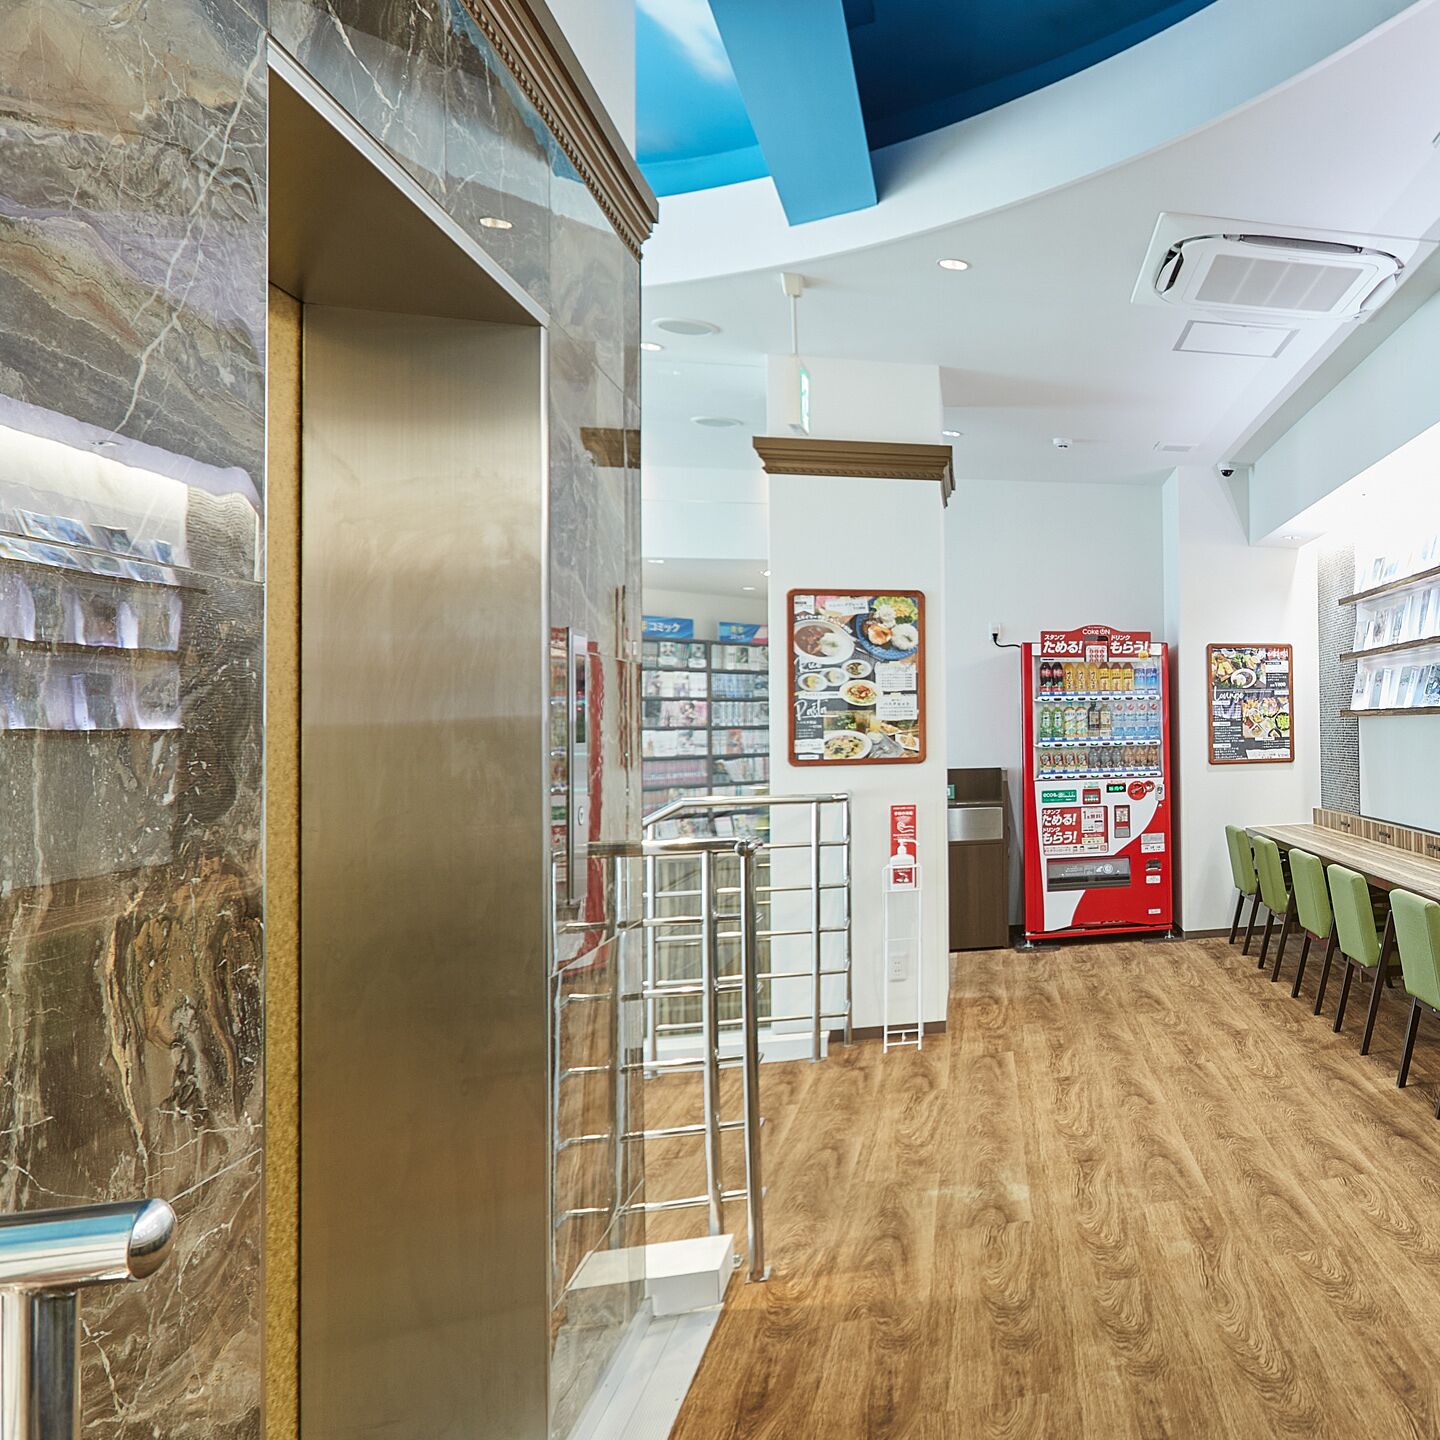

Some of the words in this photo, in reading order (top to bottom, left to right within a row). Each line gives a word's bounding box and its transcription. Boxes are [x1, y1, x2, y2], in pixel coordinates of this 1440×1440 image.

[649, 622, 680, 633] コミック
[1042, 640, 1083, 654] ためる!
[794, 698, 828, 721] Pasta
[1042, 813, 1077, 826] ためる!
